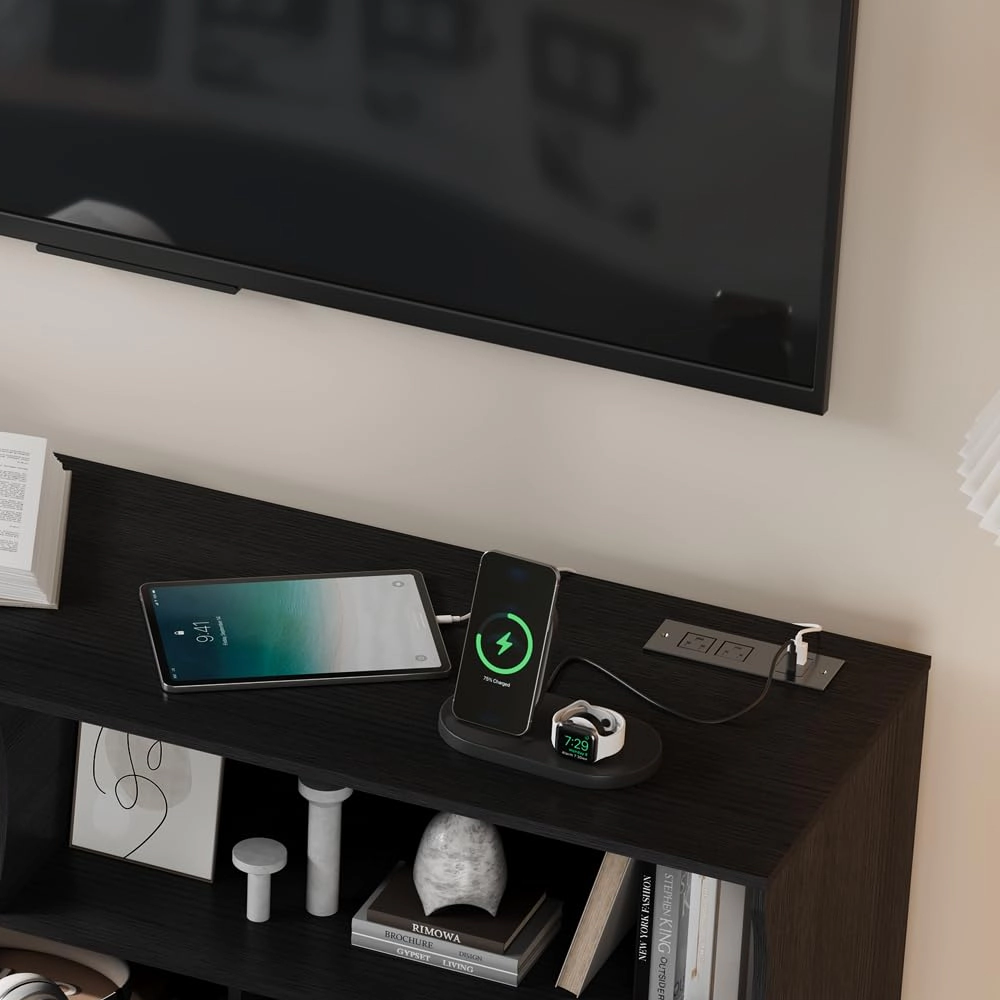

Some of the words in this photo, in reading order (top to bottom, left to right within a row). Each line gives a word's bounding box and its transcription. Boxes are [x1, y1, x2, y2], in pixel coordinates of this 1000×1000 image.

[563, 735, 589, 752] 7:29
[641, 875, 652, 914] FASHION
[661, 873, 674, 916] STEPHEN
[411, 923, 461, 944] RIMOWA
[639, 912, 650, 940] YORK
[657, 917, 674, 954] KING
[384, 930, 434, 949] BROCHURE
[638, 939, 648, 962] NEW
[396, 948, 431, 962] GYPSET
[442, 959, 474, 973] LIVING
[656, 956, 668, 1000] OUTSIDER
